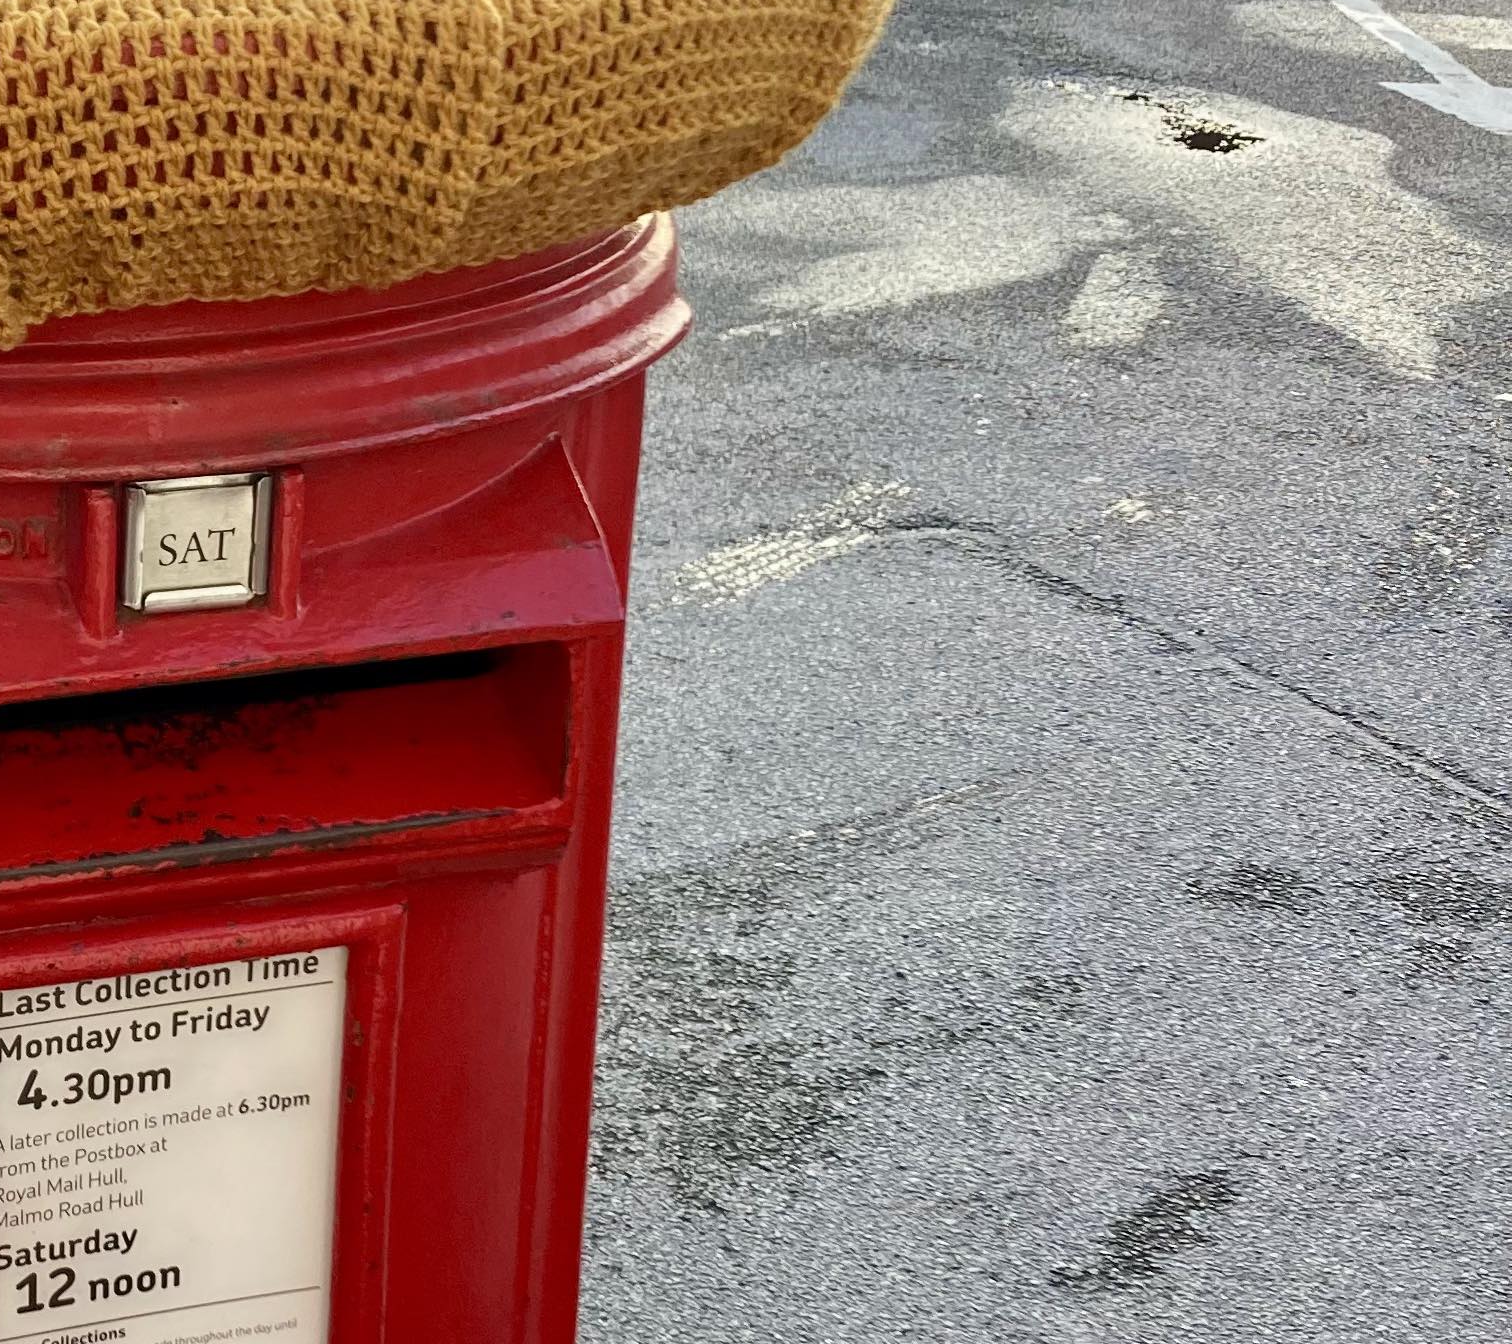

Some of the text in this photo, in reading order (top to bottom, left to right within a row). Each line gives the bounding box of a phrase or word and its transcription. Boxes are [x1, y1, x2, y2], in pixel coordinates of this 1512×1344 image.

[158, 527, 236, 567] SAT
[75, 965, 231, 1007] Collection
[241, 954, 319, 982] Time
[129, 1019, 162, 1042] to
[172, 1004, 270, 1037] Friday
[17, 1067, 171, 1110] 4.30pm
[10, 1131, 52, 1151] later
[55, 1117, 139, 1144] collection
[144, 1112, 158, 1129] is
[162, 1104, 212, 1126] made
[216, 1102, 234, 1119] at
[238, 1093, 310, 1115] 6.30pm
[41, 1156, 71, 1172] the
[74, 1141, 147, 1166] Postbox
[150, 1136, 169, 1154] at
[46, 1174, 84, 1196] Mail
[88, 1167, 129, 1190] Hull,
[59, 1196, 104, 1219] Road
[108, 1188, 144, 1211] Hull
[16, 1265, 182, 1315] 12 noon
[235, 1323, 253, 1338] the
[254, 1321, 273, 1336] day
[274, 1317, 299, 1333] until
